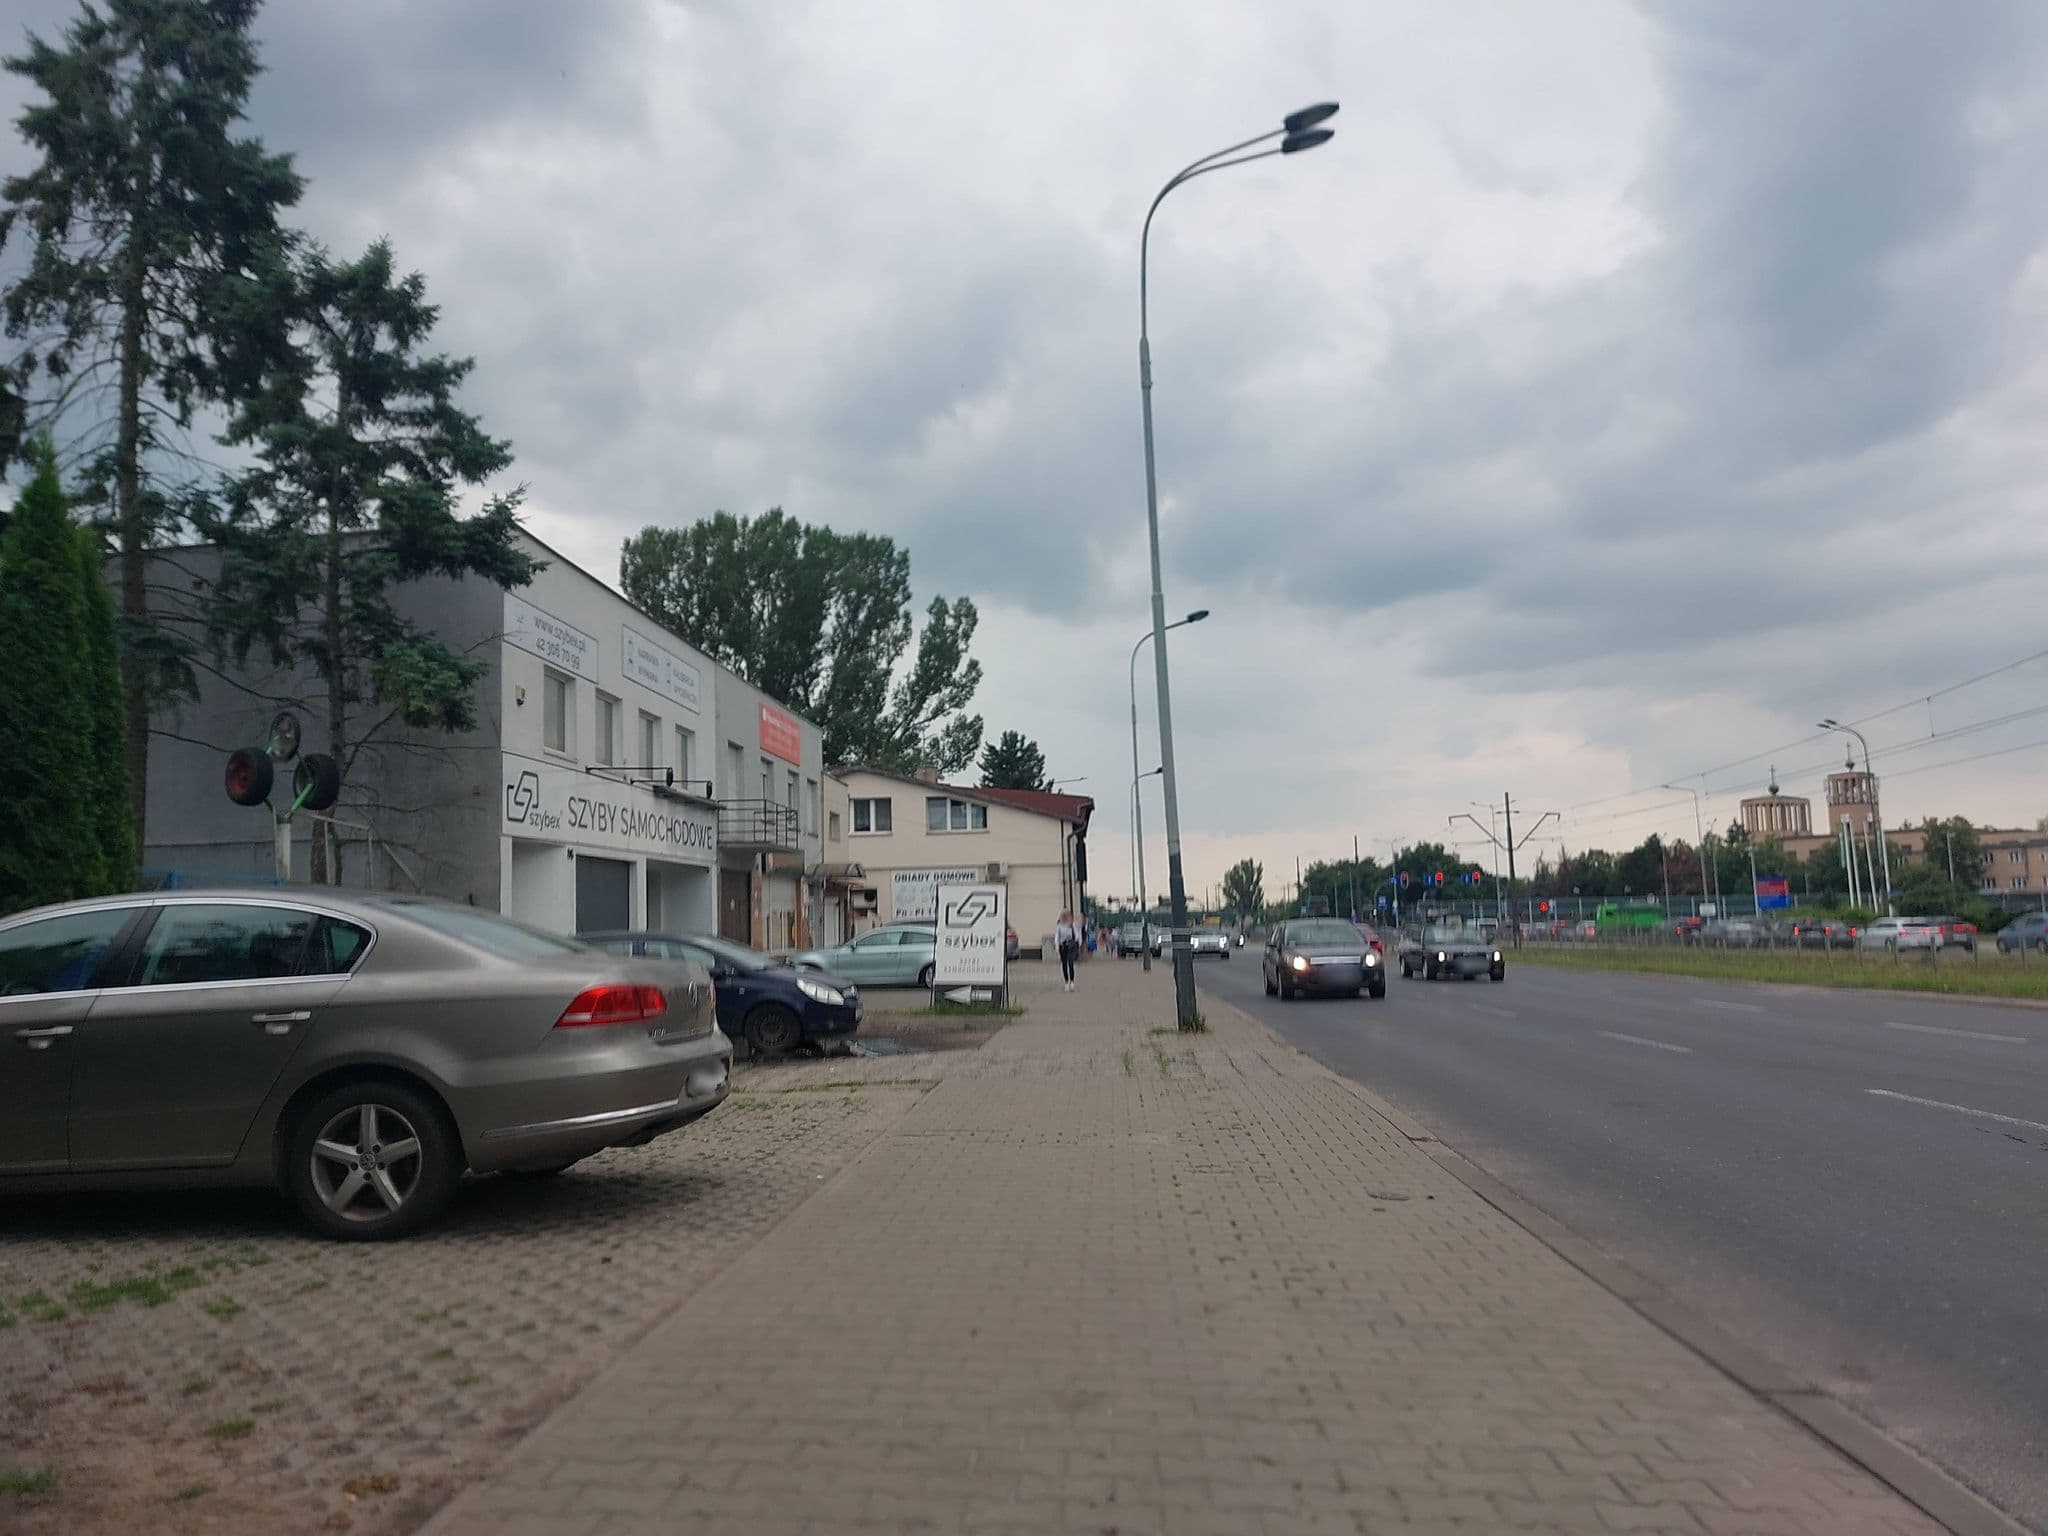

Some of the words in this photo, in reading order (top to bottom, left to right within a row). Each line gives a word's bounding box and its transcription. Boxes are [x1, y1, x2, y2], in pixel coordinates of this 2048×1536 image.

[529, 809, 560, 832] szybex
[568, 796, 617, 834] SZYBY
[620, 807, 713, 850] SAMOCHODOWE
[944, 932, 996, 951] szybex
